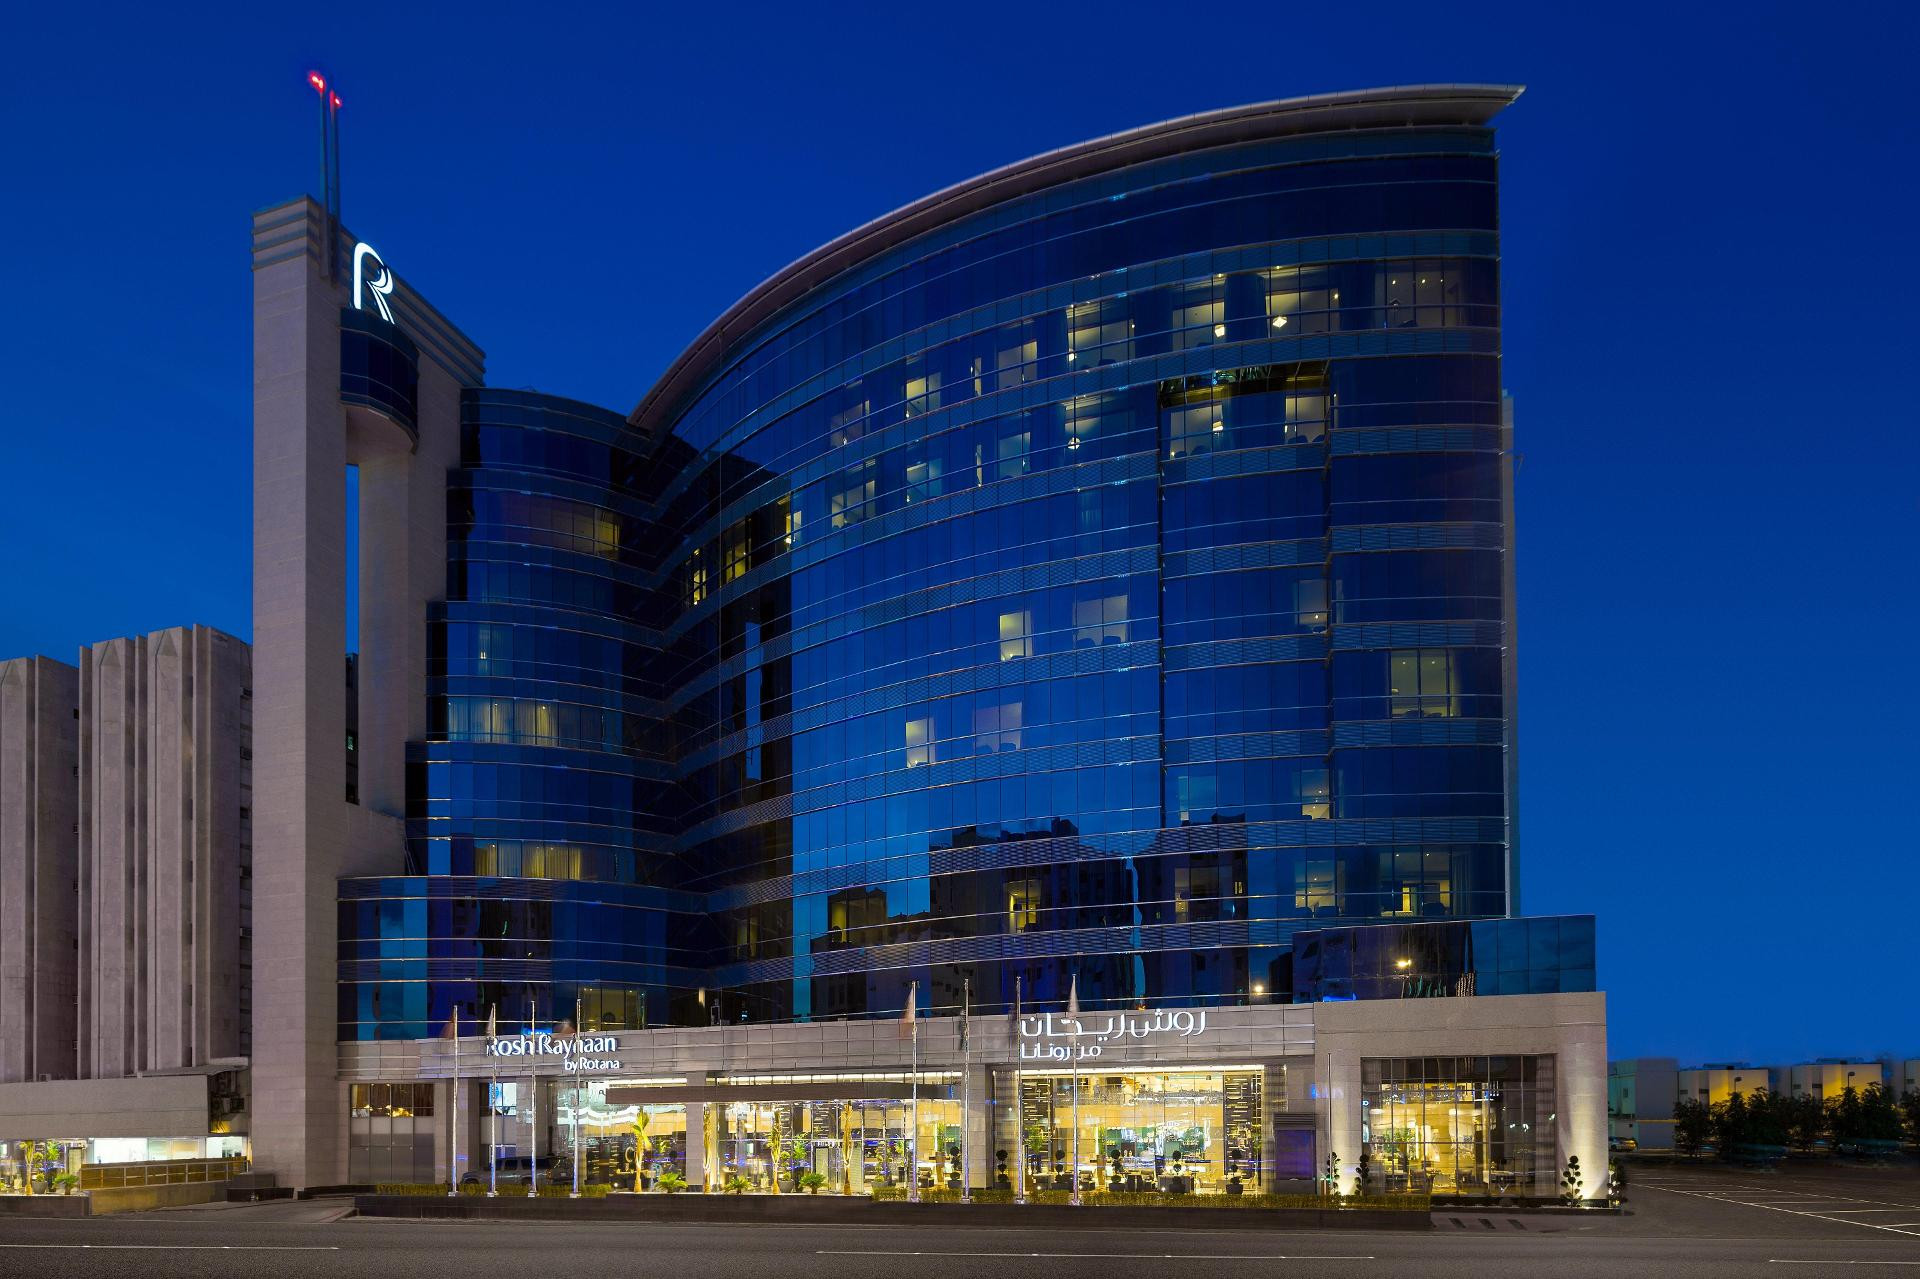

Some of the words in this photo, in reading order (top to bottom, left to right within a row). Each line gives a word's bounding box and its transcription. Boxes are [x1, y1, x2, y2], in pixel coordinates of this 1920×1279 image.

[353, 242, 395, 325] R
[1130, 1008, 1206, 1038] روش
[1075, 1042, 1102, 1060] من
[565, 1059, 578, 1074] by
[579, 1057, 620, 1070] Rotana
